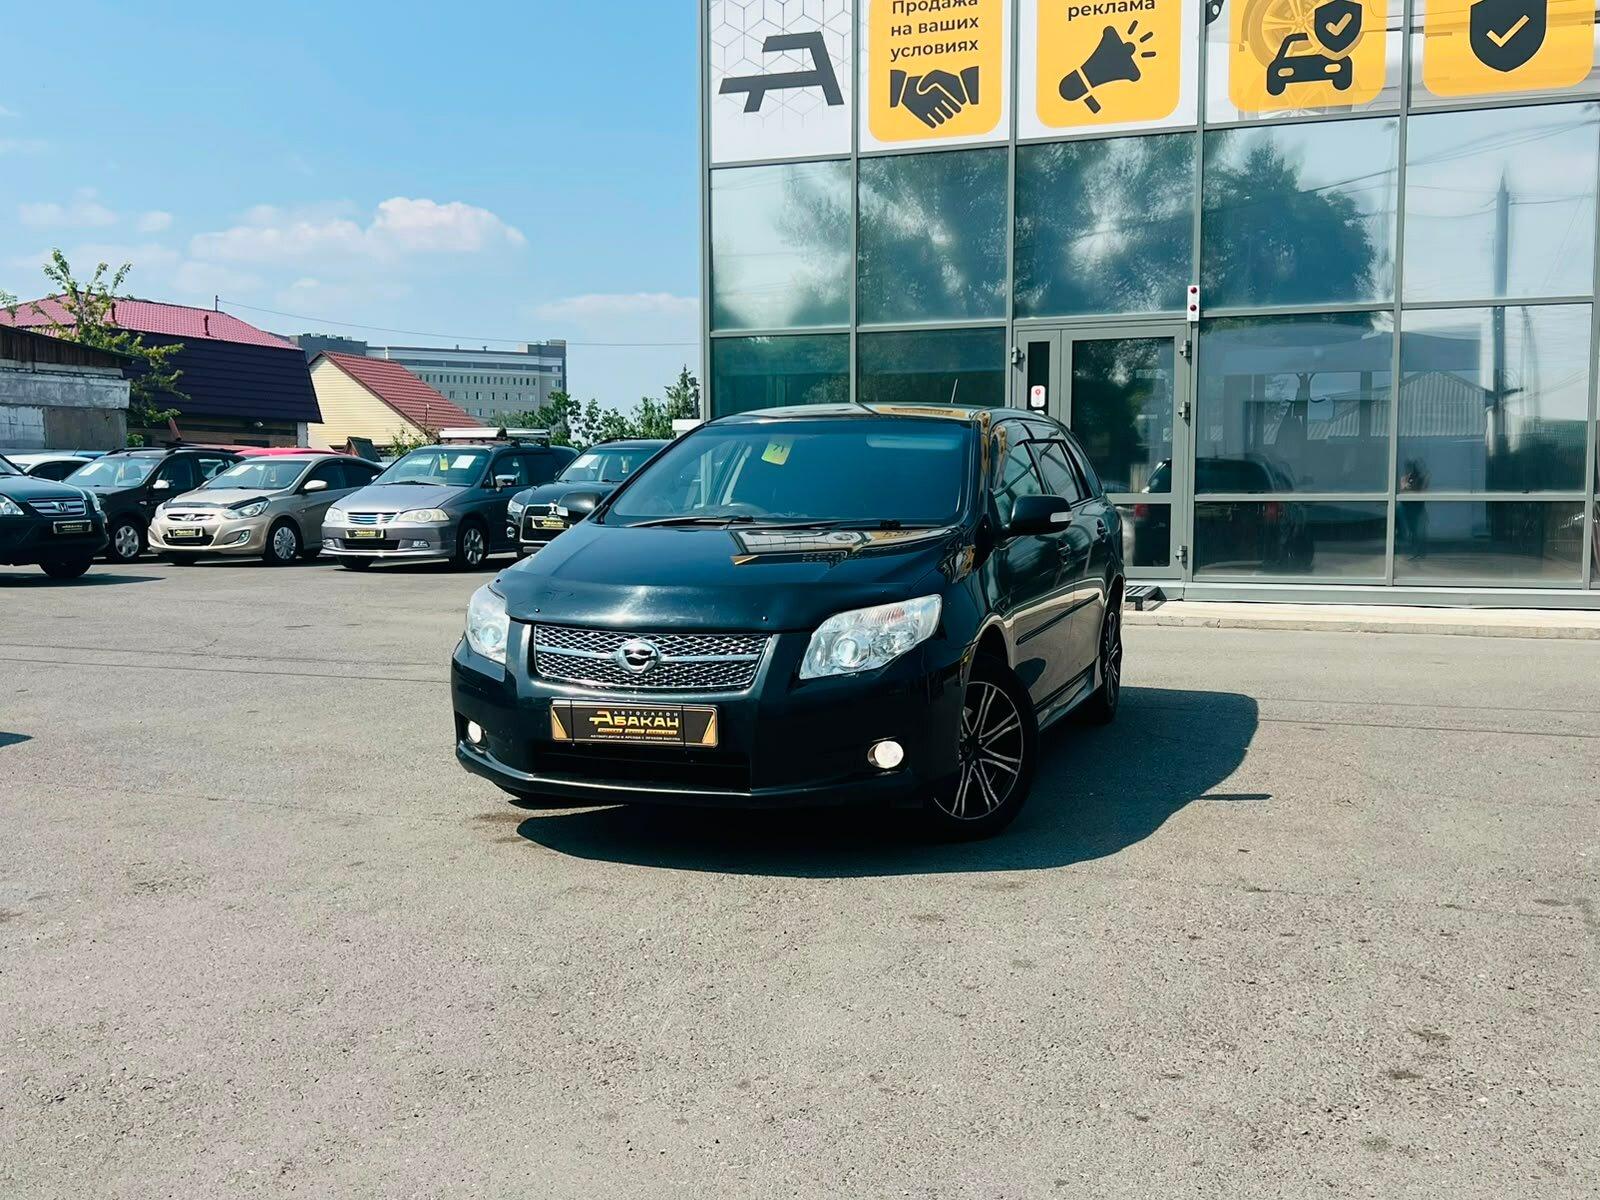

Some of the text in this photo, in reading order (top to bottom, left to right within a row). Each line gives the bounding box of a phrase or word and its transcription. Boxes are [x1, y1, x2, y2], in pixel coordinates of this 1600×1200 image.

[1067, 0, 1156, 21] реклама
[890, 17, 979, 37] на ваших
[890, 39, 979, 62] условиях
